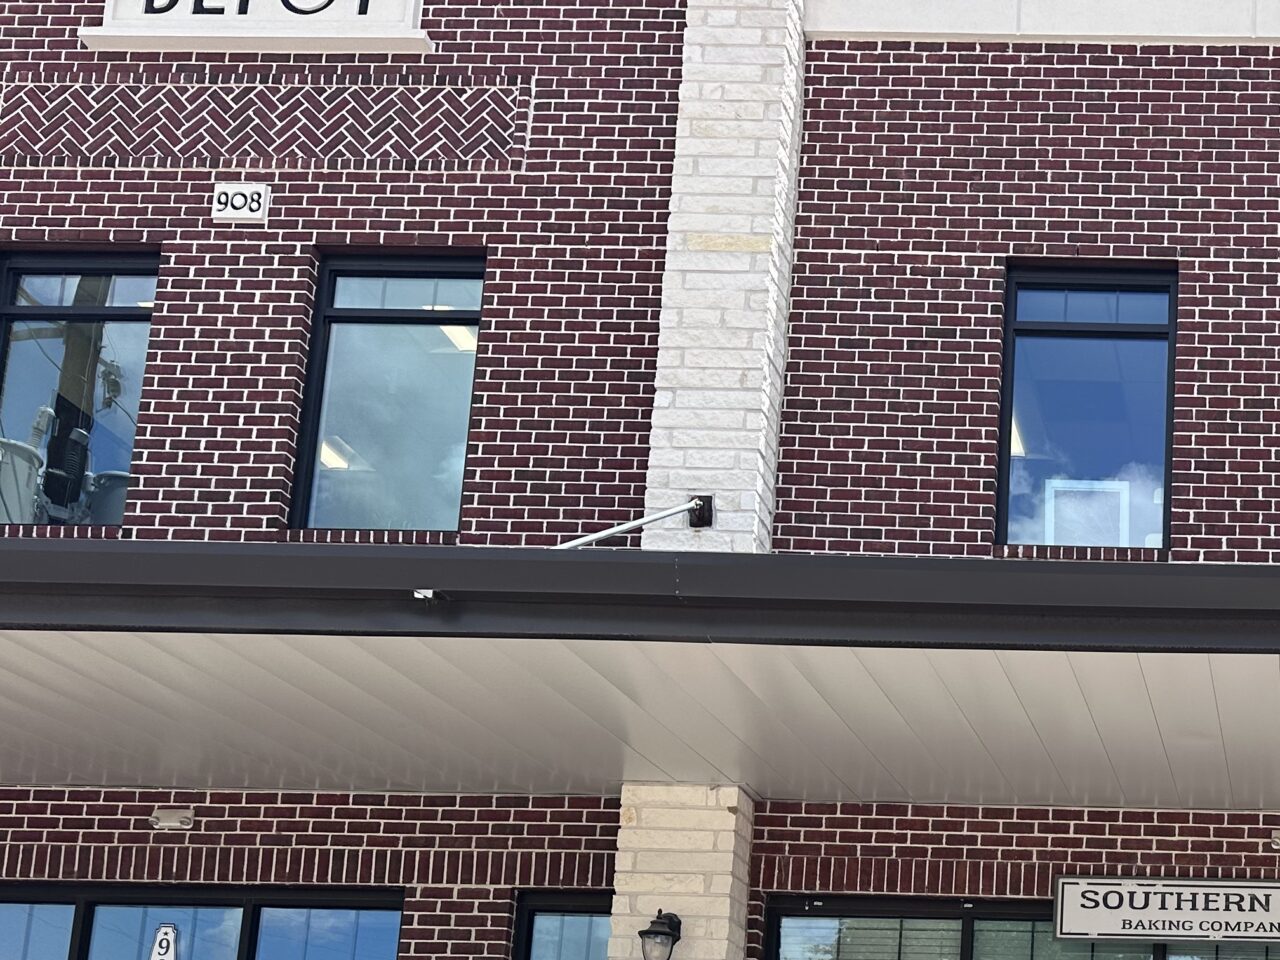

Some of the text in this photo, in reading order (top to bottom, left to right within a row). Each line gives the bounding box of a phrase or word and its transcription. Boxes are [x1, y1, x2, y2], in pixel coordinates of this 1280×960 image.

[216, 191, 262, 213] 908
[1080, 889, 1272, 914] SOUTHERN
[1121, 918, 1194, 932] BAKING
